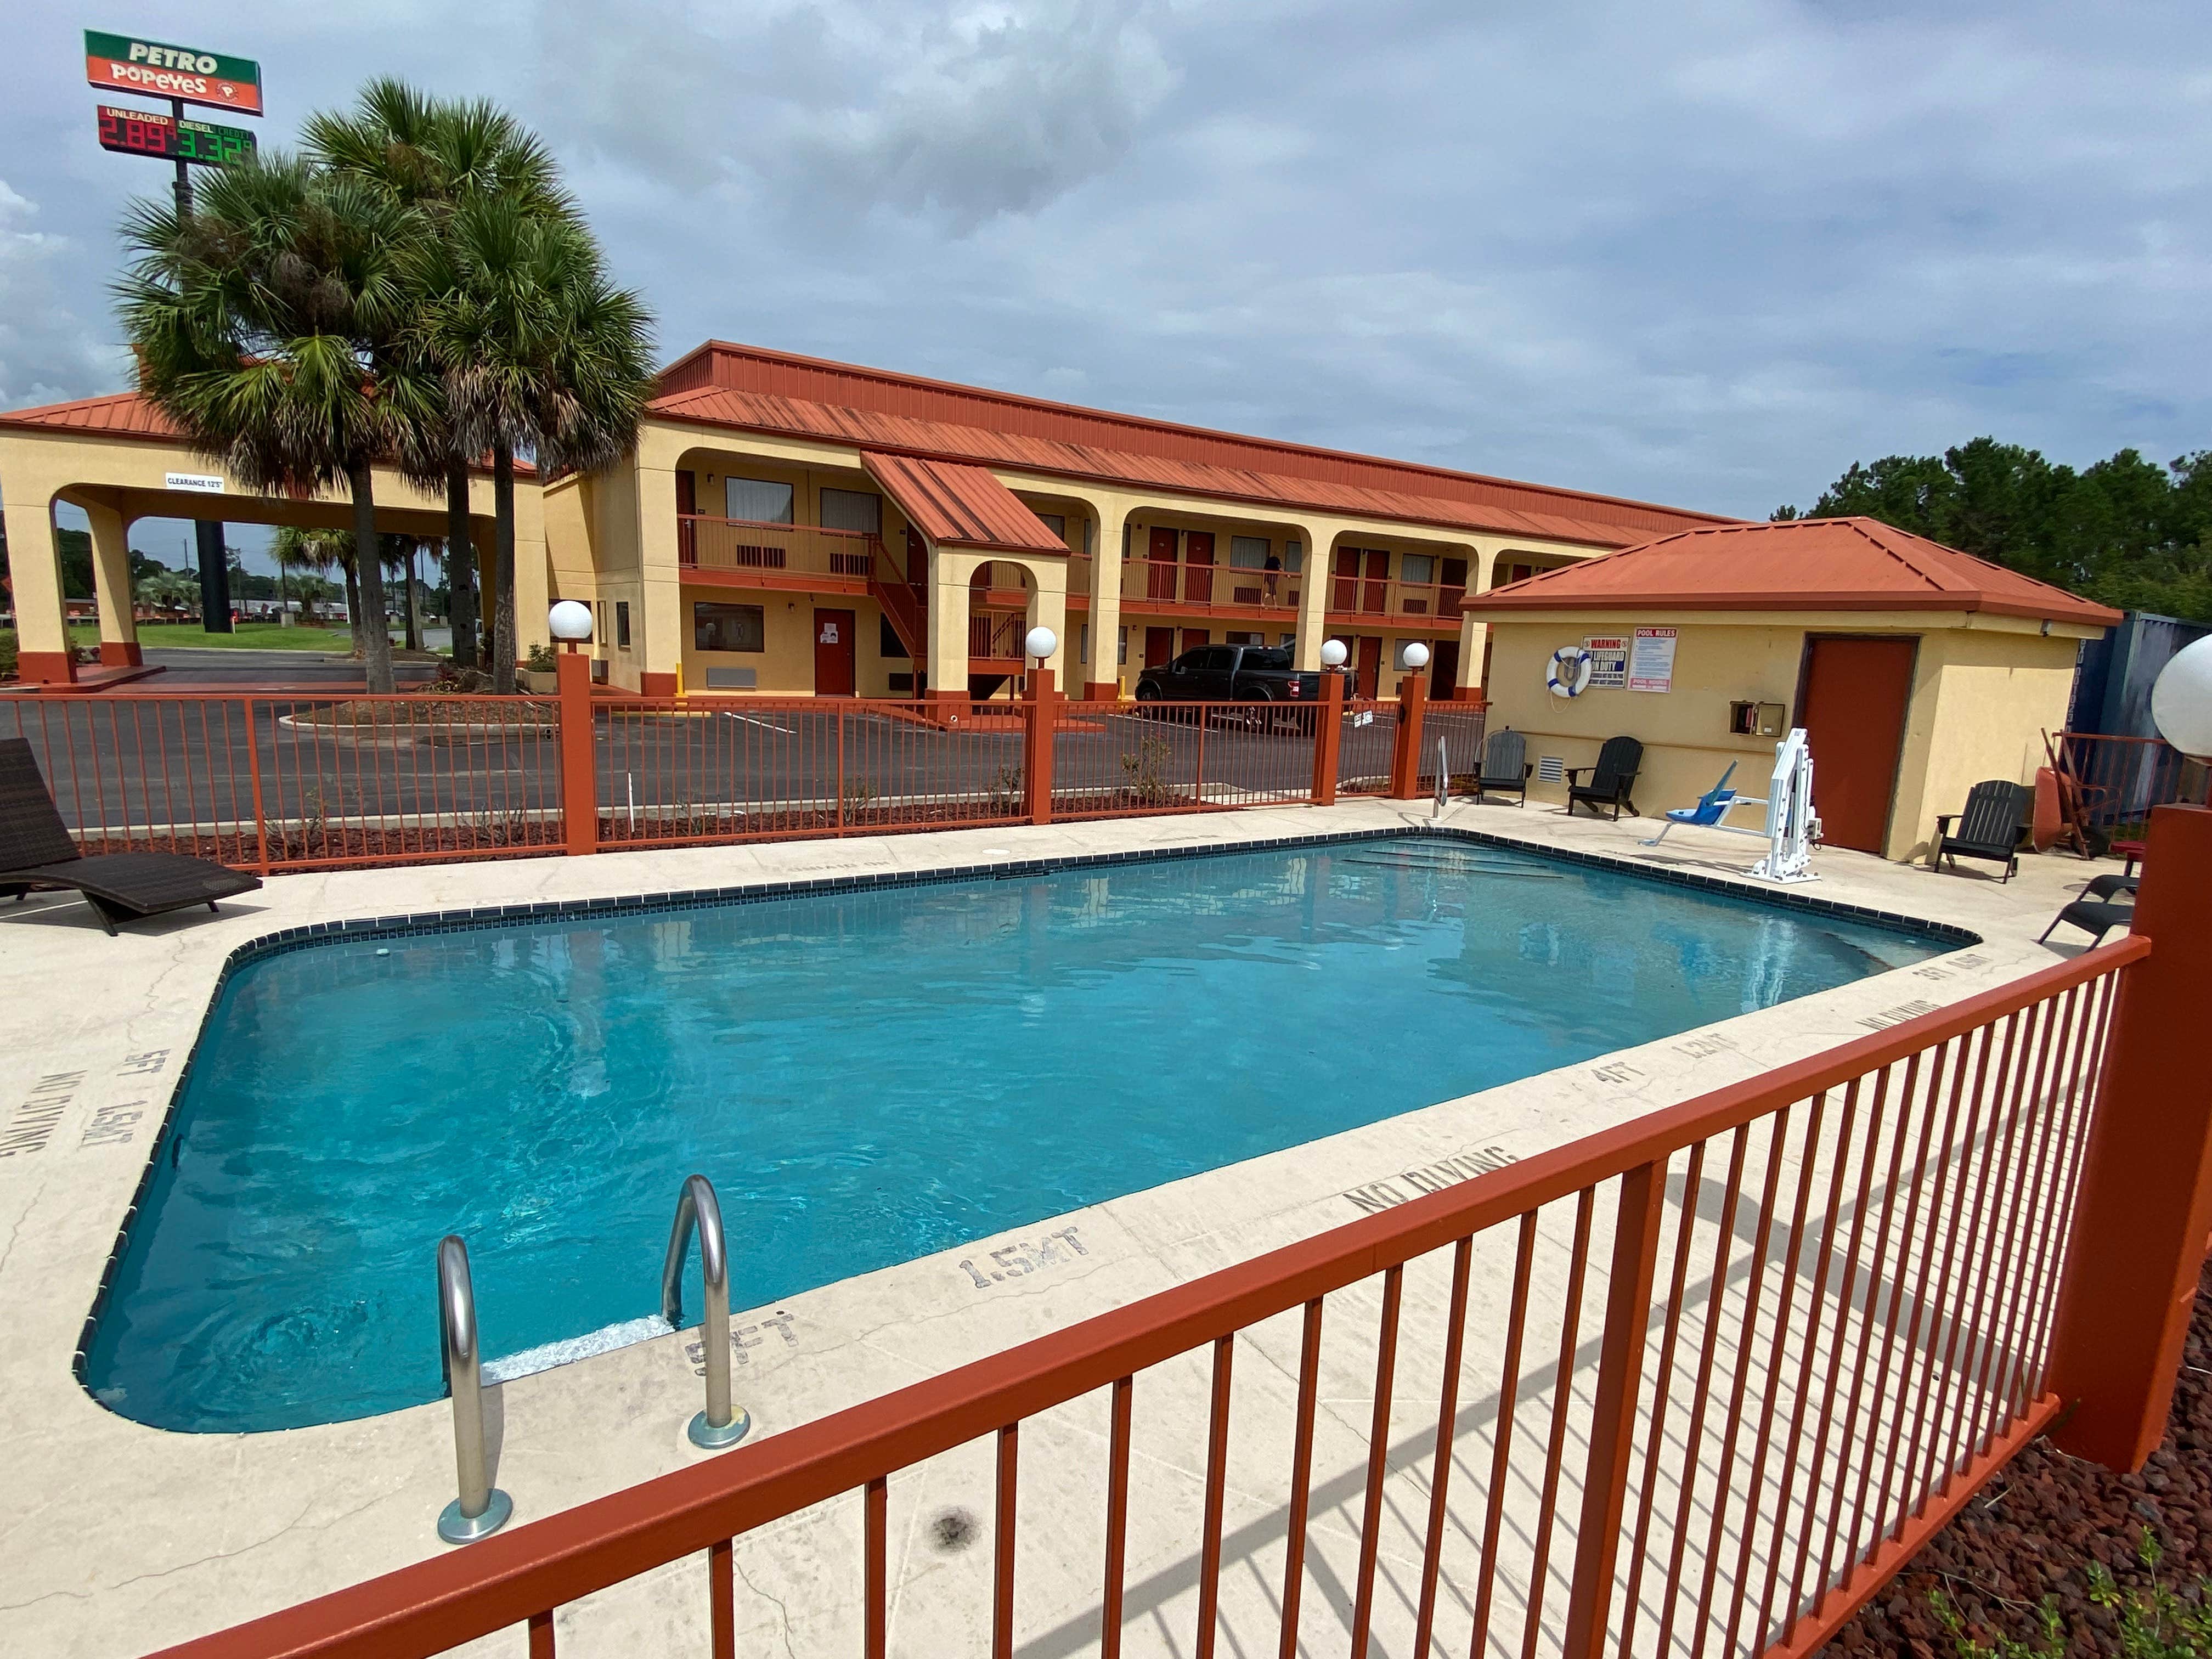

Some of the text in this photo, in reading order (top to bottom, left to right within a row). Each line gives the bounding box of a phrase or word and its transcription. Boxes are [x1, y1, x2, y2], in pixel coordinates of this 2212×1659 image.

[129, 43, 218, 75] PETRO
[107, 108, 168, 125] UNLEADED
[179, 120, 213, 133] DIESEL
[167, 478, 206, 487] CLEARANCE
[1591, 639, 1621, 648] WARNING
[1594, 651, 1624, 662] LIFEGUARD
[1600, 661, 1616, 671] DUTY
[1590, 1061, 1646, 1084] 4FT
[1342, 1146, 1521, 1214] NO DIVING
[959, 1226, 1089, 1289] 1.5MT
